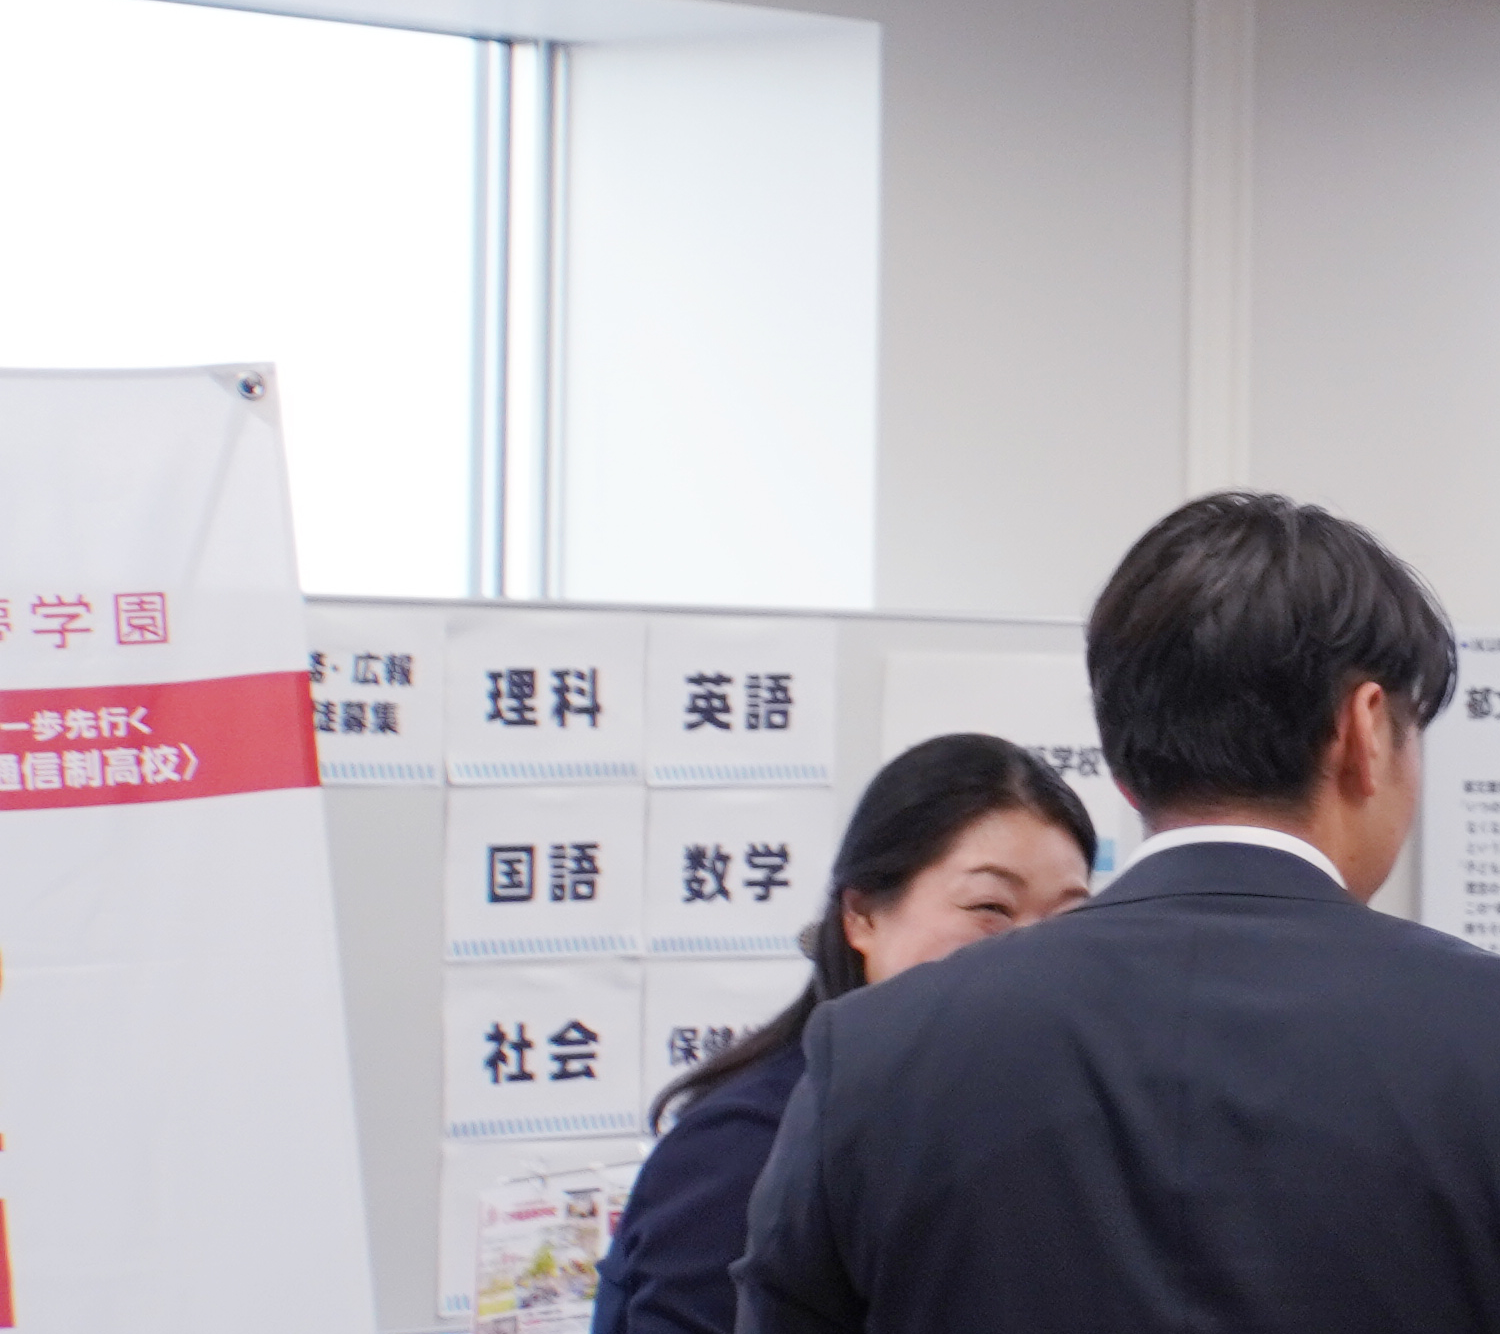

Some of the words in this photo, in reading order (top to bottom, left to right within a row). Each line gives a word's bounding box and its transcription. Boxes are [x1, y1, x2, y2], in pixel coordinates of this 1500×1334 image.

[0, 591, 171, 654] 学園
[485, 666, 602, 729] 理科
[683, 671, 795, 732] 英語
[487, 842, 602, 903] 国語
[682, 842, 793, 903] 数学
[484, 1020, 600, 1084] 社会
